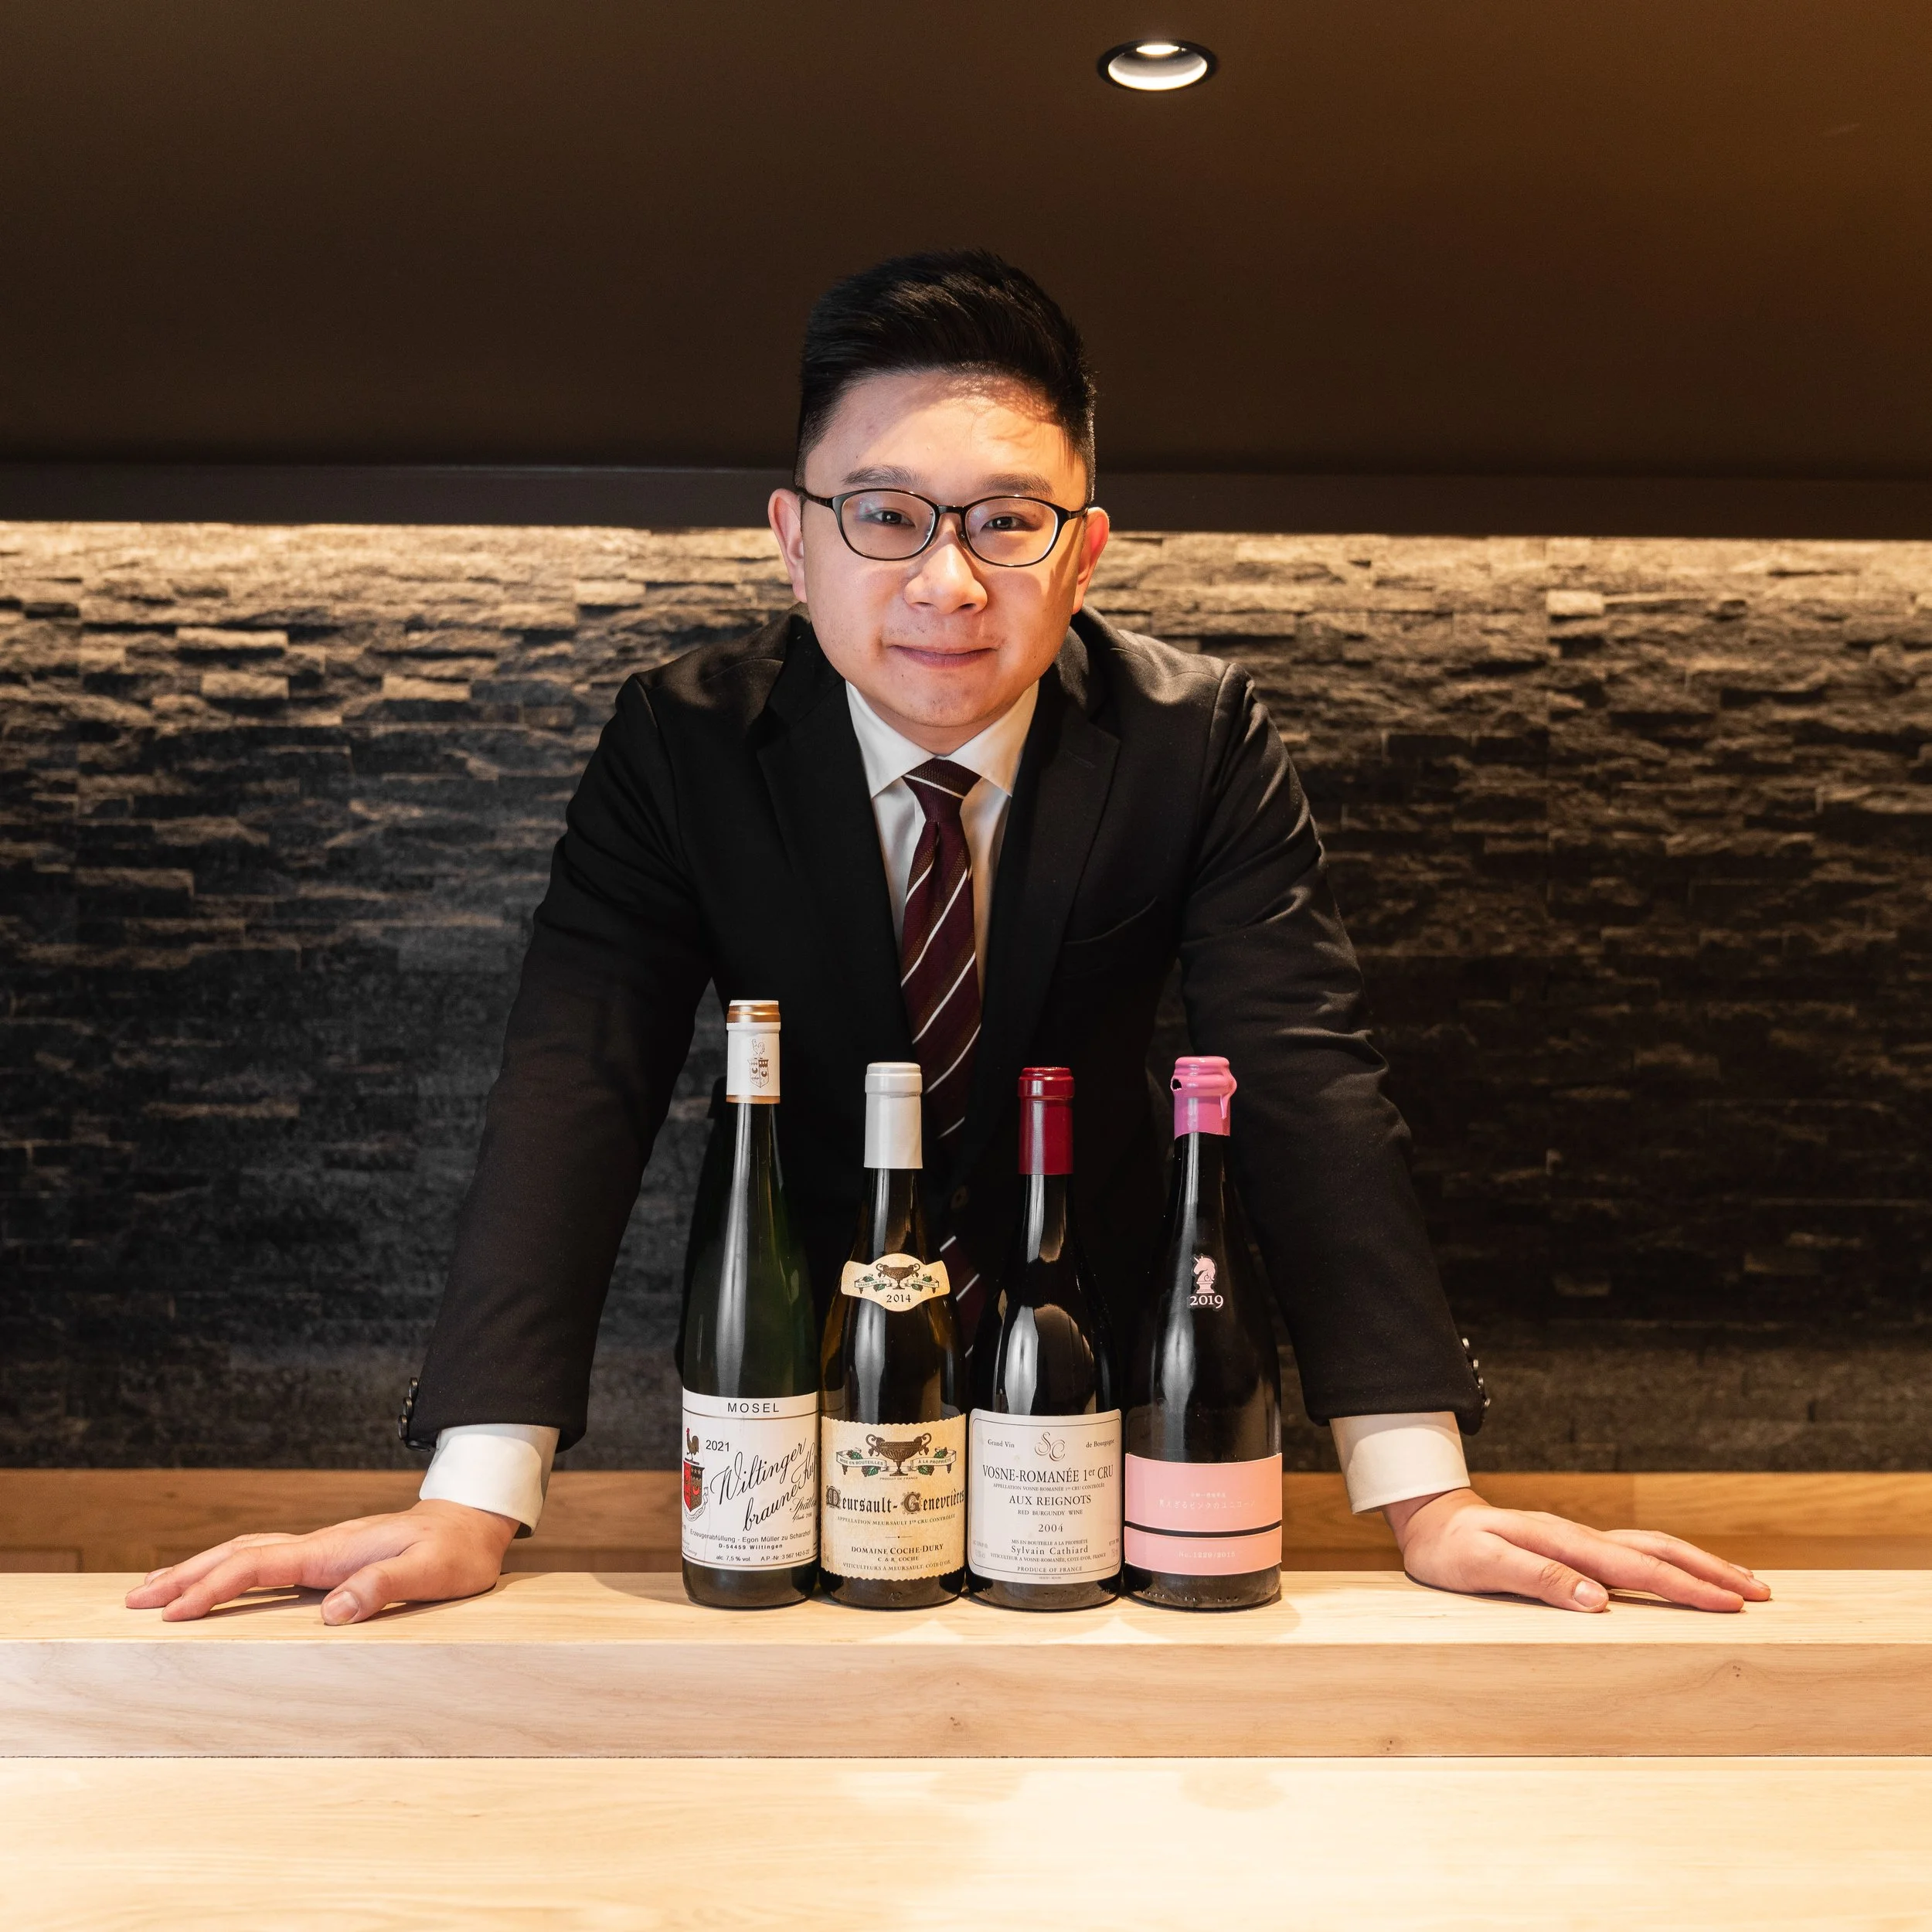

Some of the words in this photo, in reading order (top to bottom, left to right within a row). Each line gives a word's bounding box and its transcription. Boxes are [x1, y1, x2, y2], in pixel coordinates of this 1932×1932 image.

[886, 1294, 911, 1303] 2014
[1190, 1295, 1224, 1309] 2019
[727, 1403, 780, 1413] MOSEL
[706, 1439, 730, 1451] 2021
[1094, 1439, 1114, 1448] Bourgogne
[710, 1437, 807, 1505] Wiltinger
[983, 1464, 1080, 1483] VOSNE-ROMANÉE
[1083, 1469, 1095, 1481] 1er
[1097, 1464, 1114, 1479] CRU
[1009, 1495, 1032, 1505] AUX
[1036, 1495, 1091, 1505] REIGNOTS
[743, 1482, 800, 1532] braune
[838, 1516, 871, 1526] APPELLATION
[1038, 1524, 1063, 1533] 2004
[690, 1529, 736, 1543] Erzeugerabfüllung
[852, 1546, 887, 1555] DOMAINE
[890, 1543, 944, 1555] COCHE-DURY
[1011, 1546, 1045, 1556] Sylvain
[1049, 1545, 1088, 1555] Cathiard
[991, 1553, 1019, 1561] VITICULTEUR
